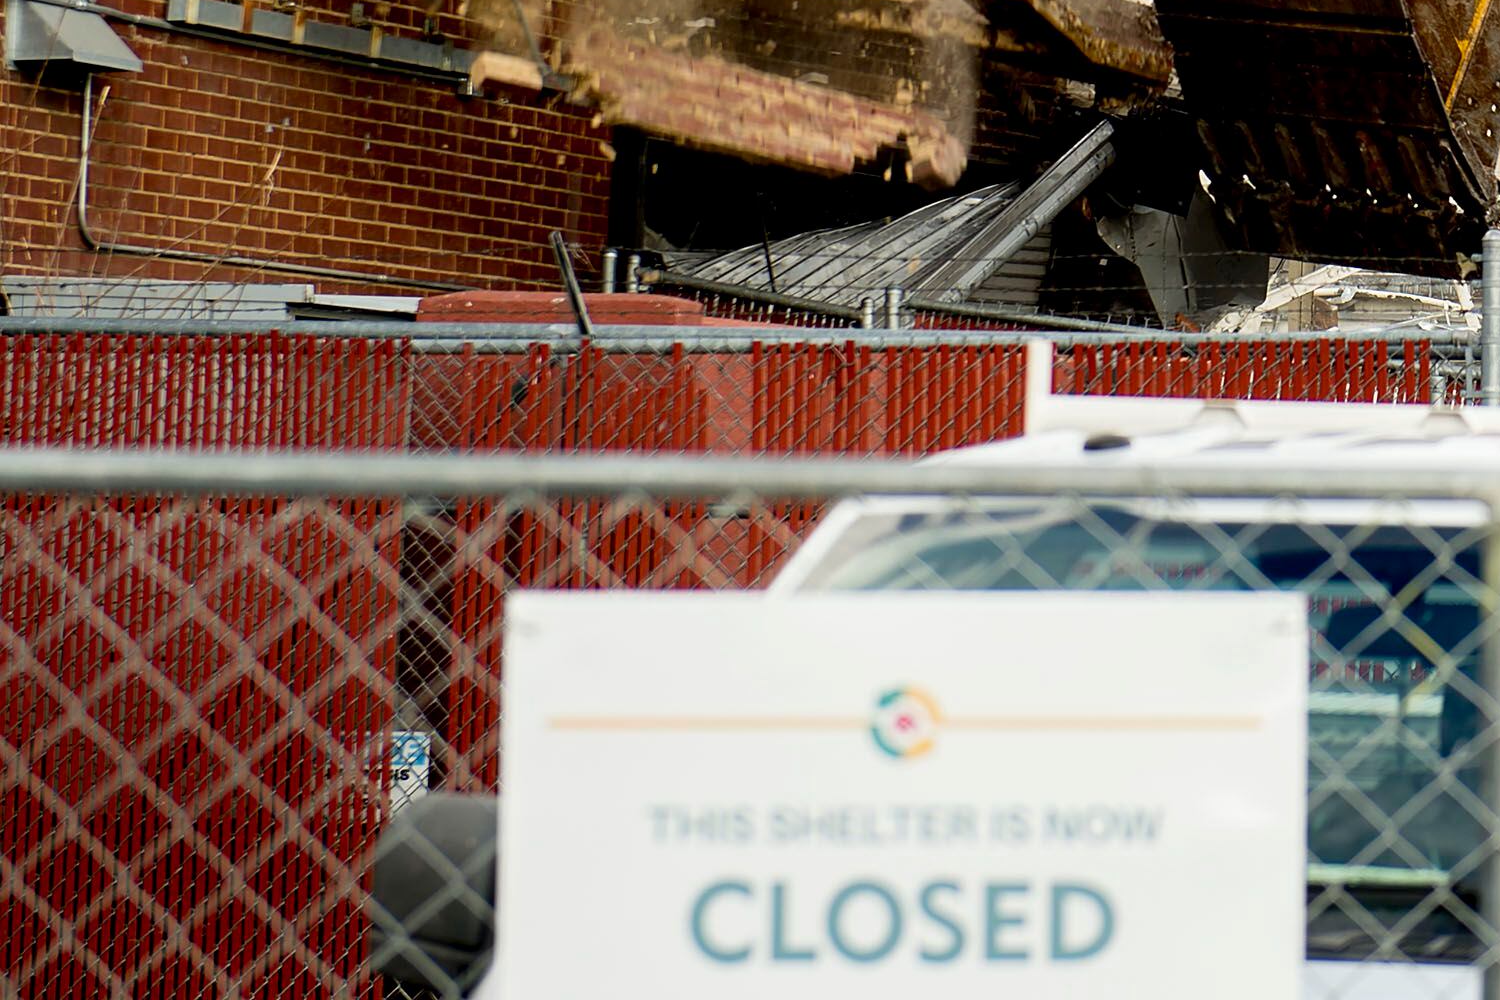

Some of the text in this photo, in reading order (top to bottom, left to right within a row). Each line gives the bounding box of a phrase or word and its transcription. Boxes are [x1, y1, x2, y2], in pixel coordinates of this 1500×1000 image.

[649, 804, 1163, 843] THIS SHELTER IS NOW
[689, 880, 1114, 964] CLOSED
